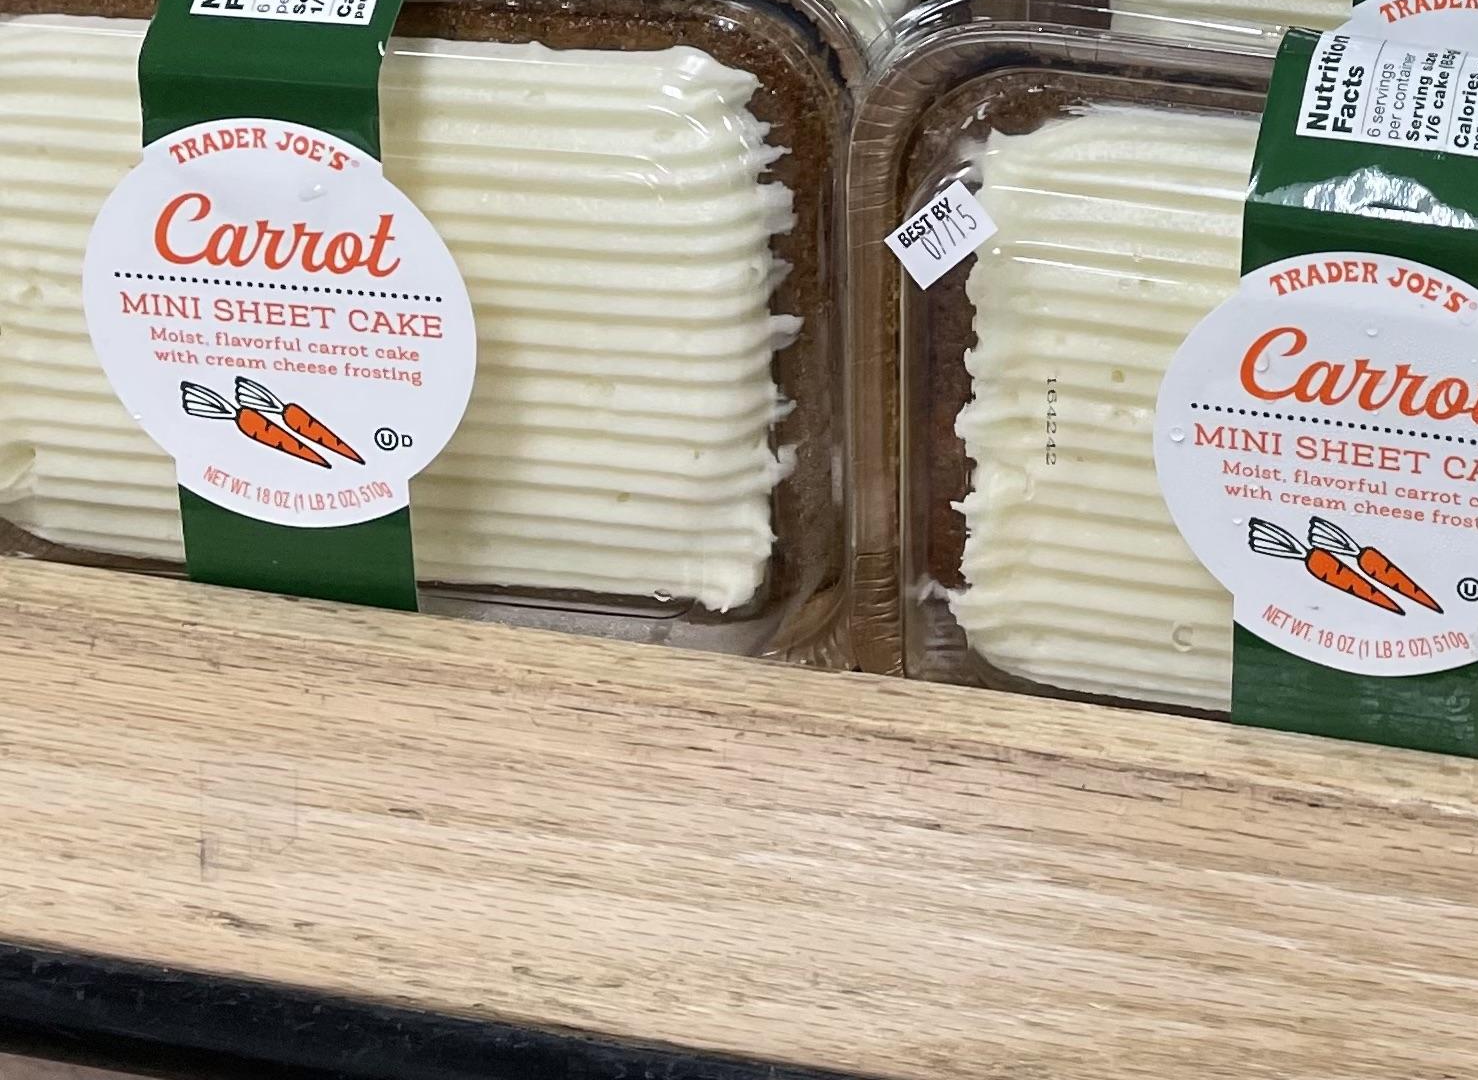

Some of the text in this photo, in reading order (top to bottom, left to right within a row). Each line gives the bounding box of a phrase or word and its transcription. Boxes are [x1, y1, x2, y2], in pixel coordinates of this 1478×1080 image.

[1306, 35, 1351, 131] Nutrition
[1333, 65, 1365, 134] Facts
[169, 128, 350, 171] TRADER JOE'S
[154, 193, 400, 277] Carrot
[898, 197, 952, 248] BEST BY
[1269, 261, 1469, 314] TRADER JOE'S
[120, 292, 443, 339] MINI SHEET CAKE
[155, 349, 423, 386] with cream cheese frosting
[216, 332, 301, 352] flavorful
[308, 341, 368, 358] carrot
[375, 345, 420, 362] cake
[1193, 423, 1283, 456] MINI
[1296, 436, 1430, 475] SHEET
[1225, 482, 1272, 501] with
[1279, 490, 1347, 511] cream
[1354, 500, 1424, 522] cheese
[1294, 467, 1388, 495] flavorful
[1394, 484, 1461, 506] carrot
[1262, 604, 1288, 630] NET
[1319, 629, 1333, 648] 18
[1338, 635, 1355, 653] OZ
[1358, 640, 1369, 659] (1
[1375, 640, 1392, 658] LB
[1397, 641, 1405, 658] 2
[1409, 635, 1433, 658] OZ)
[1434, 629, 1470, 653] 510g
